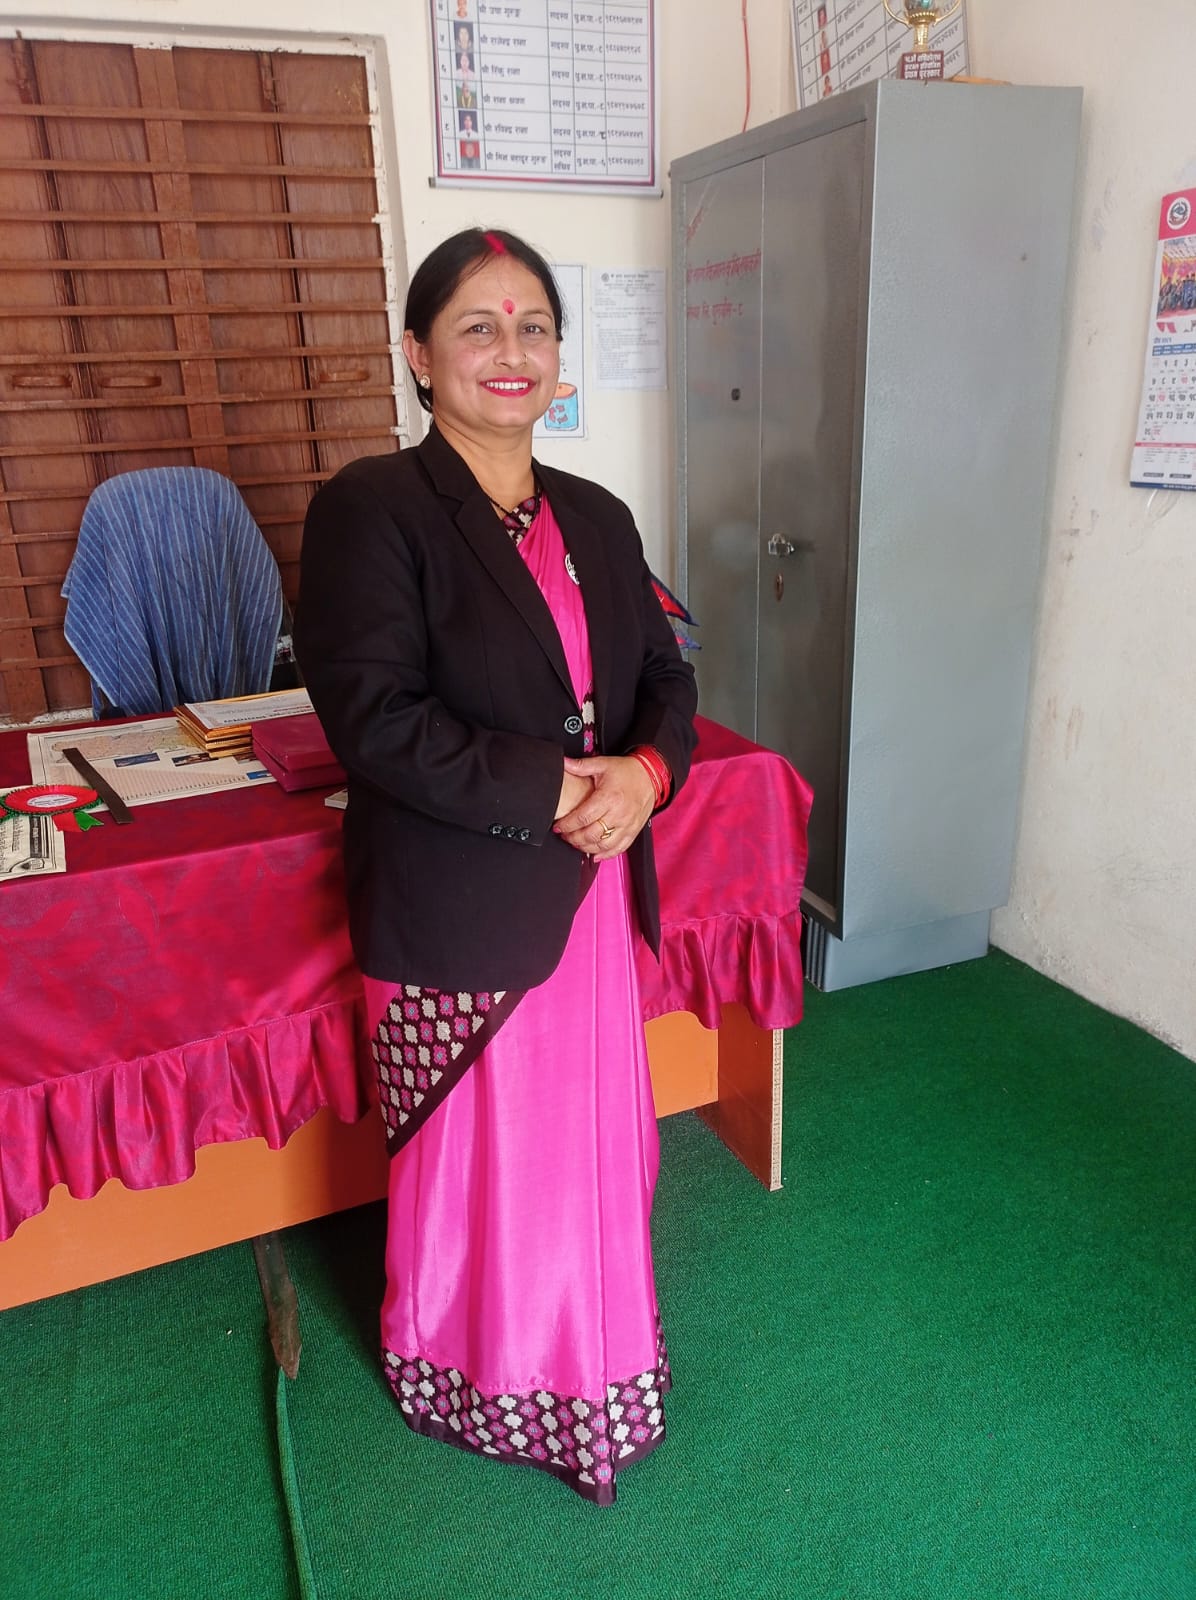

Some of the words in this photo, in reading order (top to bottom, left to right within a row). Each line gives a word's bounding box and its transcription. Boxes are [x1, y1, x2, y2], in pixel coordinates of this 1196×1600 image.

[550, 12, 569, 22] सदस्य
[480, 34, 488, 44] श्री
[550, 41, 570, 51] सदस्य
[481, 65, 489, 74] श्री
[551, 70, 570, 80] सदस्य
[483, 93, 491, 104] श्री
[552, 99, 571, 109] सदस्य
[485, 123, 493, 133] श्री
[553, 127, 571, 137] सदस्य
[486, 151, 494, 161] श्री
